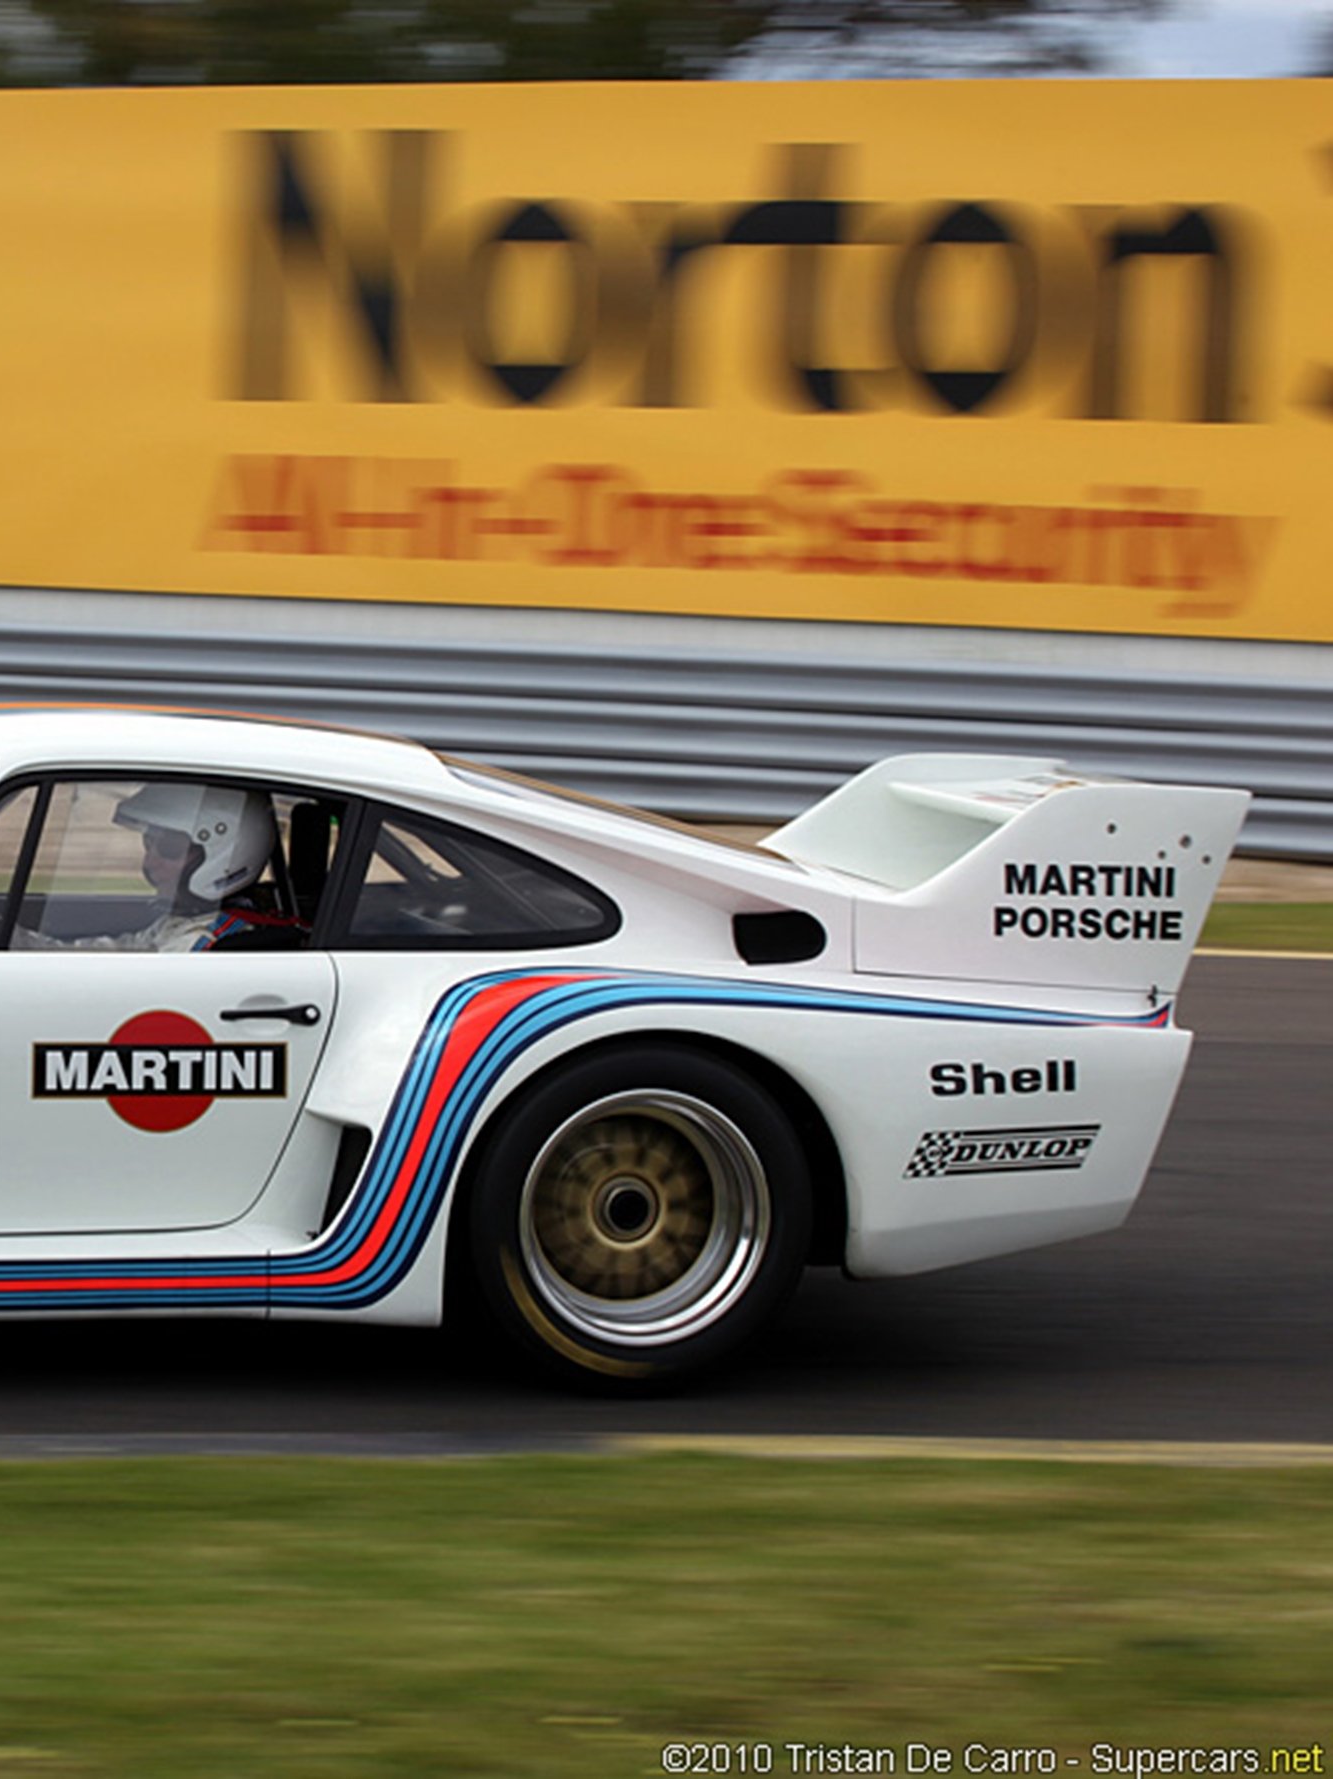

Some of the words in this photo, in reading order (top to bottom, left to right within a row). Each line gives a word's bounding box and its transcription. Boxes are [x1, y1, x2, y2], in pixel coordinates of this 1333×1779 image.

[221, 128, 1274, 424] Norton
[1003, 863, 1175, 898] MARTINI
[993, 906, 1183, 941] PORSCHE
[44, 1049, 275, 1093] MARTINI
[930, 1060, 1077, 1097] Shell
[950, 1137, 1093, 1163] DUNLOP
